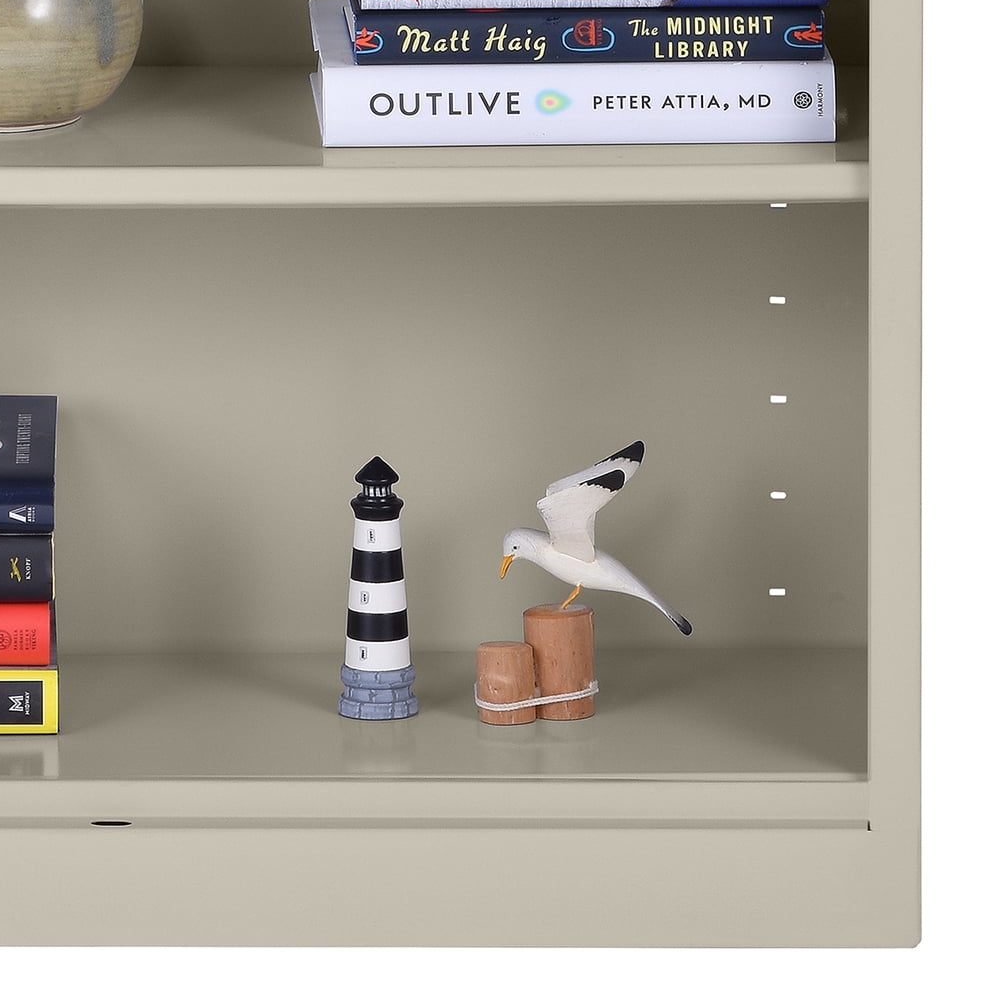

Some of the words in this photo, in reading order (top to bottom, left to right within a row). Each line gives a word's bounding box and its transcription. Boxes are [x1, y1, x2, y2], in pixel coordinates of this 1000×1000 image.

[628, 19, 659, 37] The
[666, 15, 774, 36] MIDNIGHT
[396, 24, 471, 53] Matt
[483, 23, 548, 61] Haig
[654, 40, 749, 59] LIBRARY
[369, 92, 521, 117] OUTLIVE
[593, 95, 652, 110] PETER
[661, 95, 729, 111] ATTIA,
[739, 94, 771, 109] MD
[816, 83, 824, 117] HARMONY
